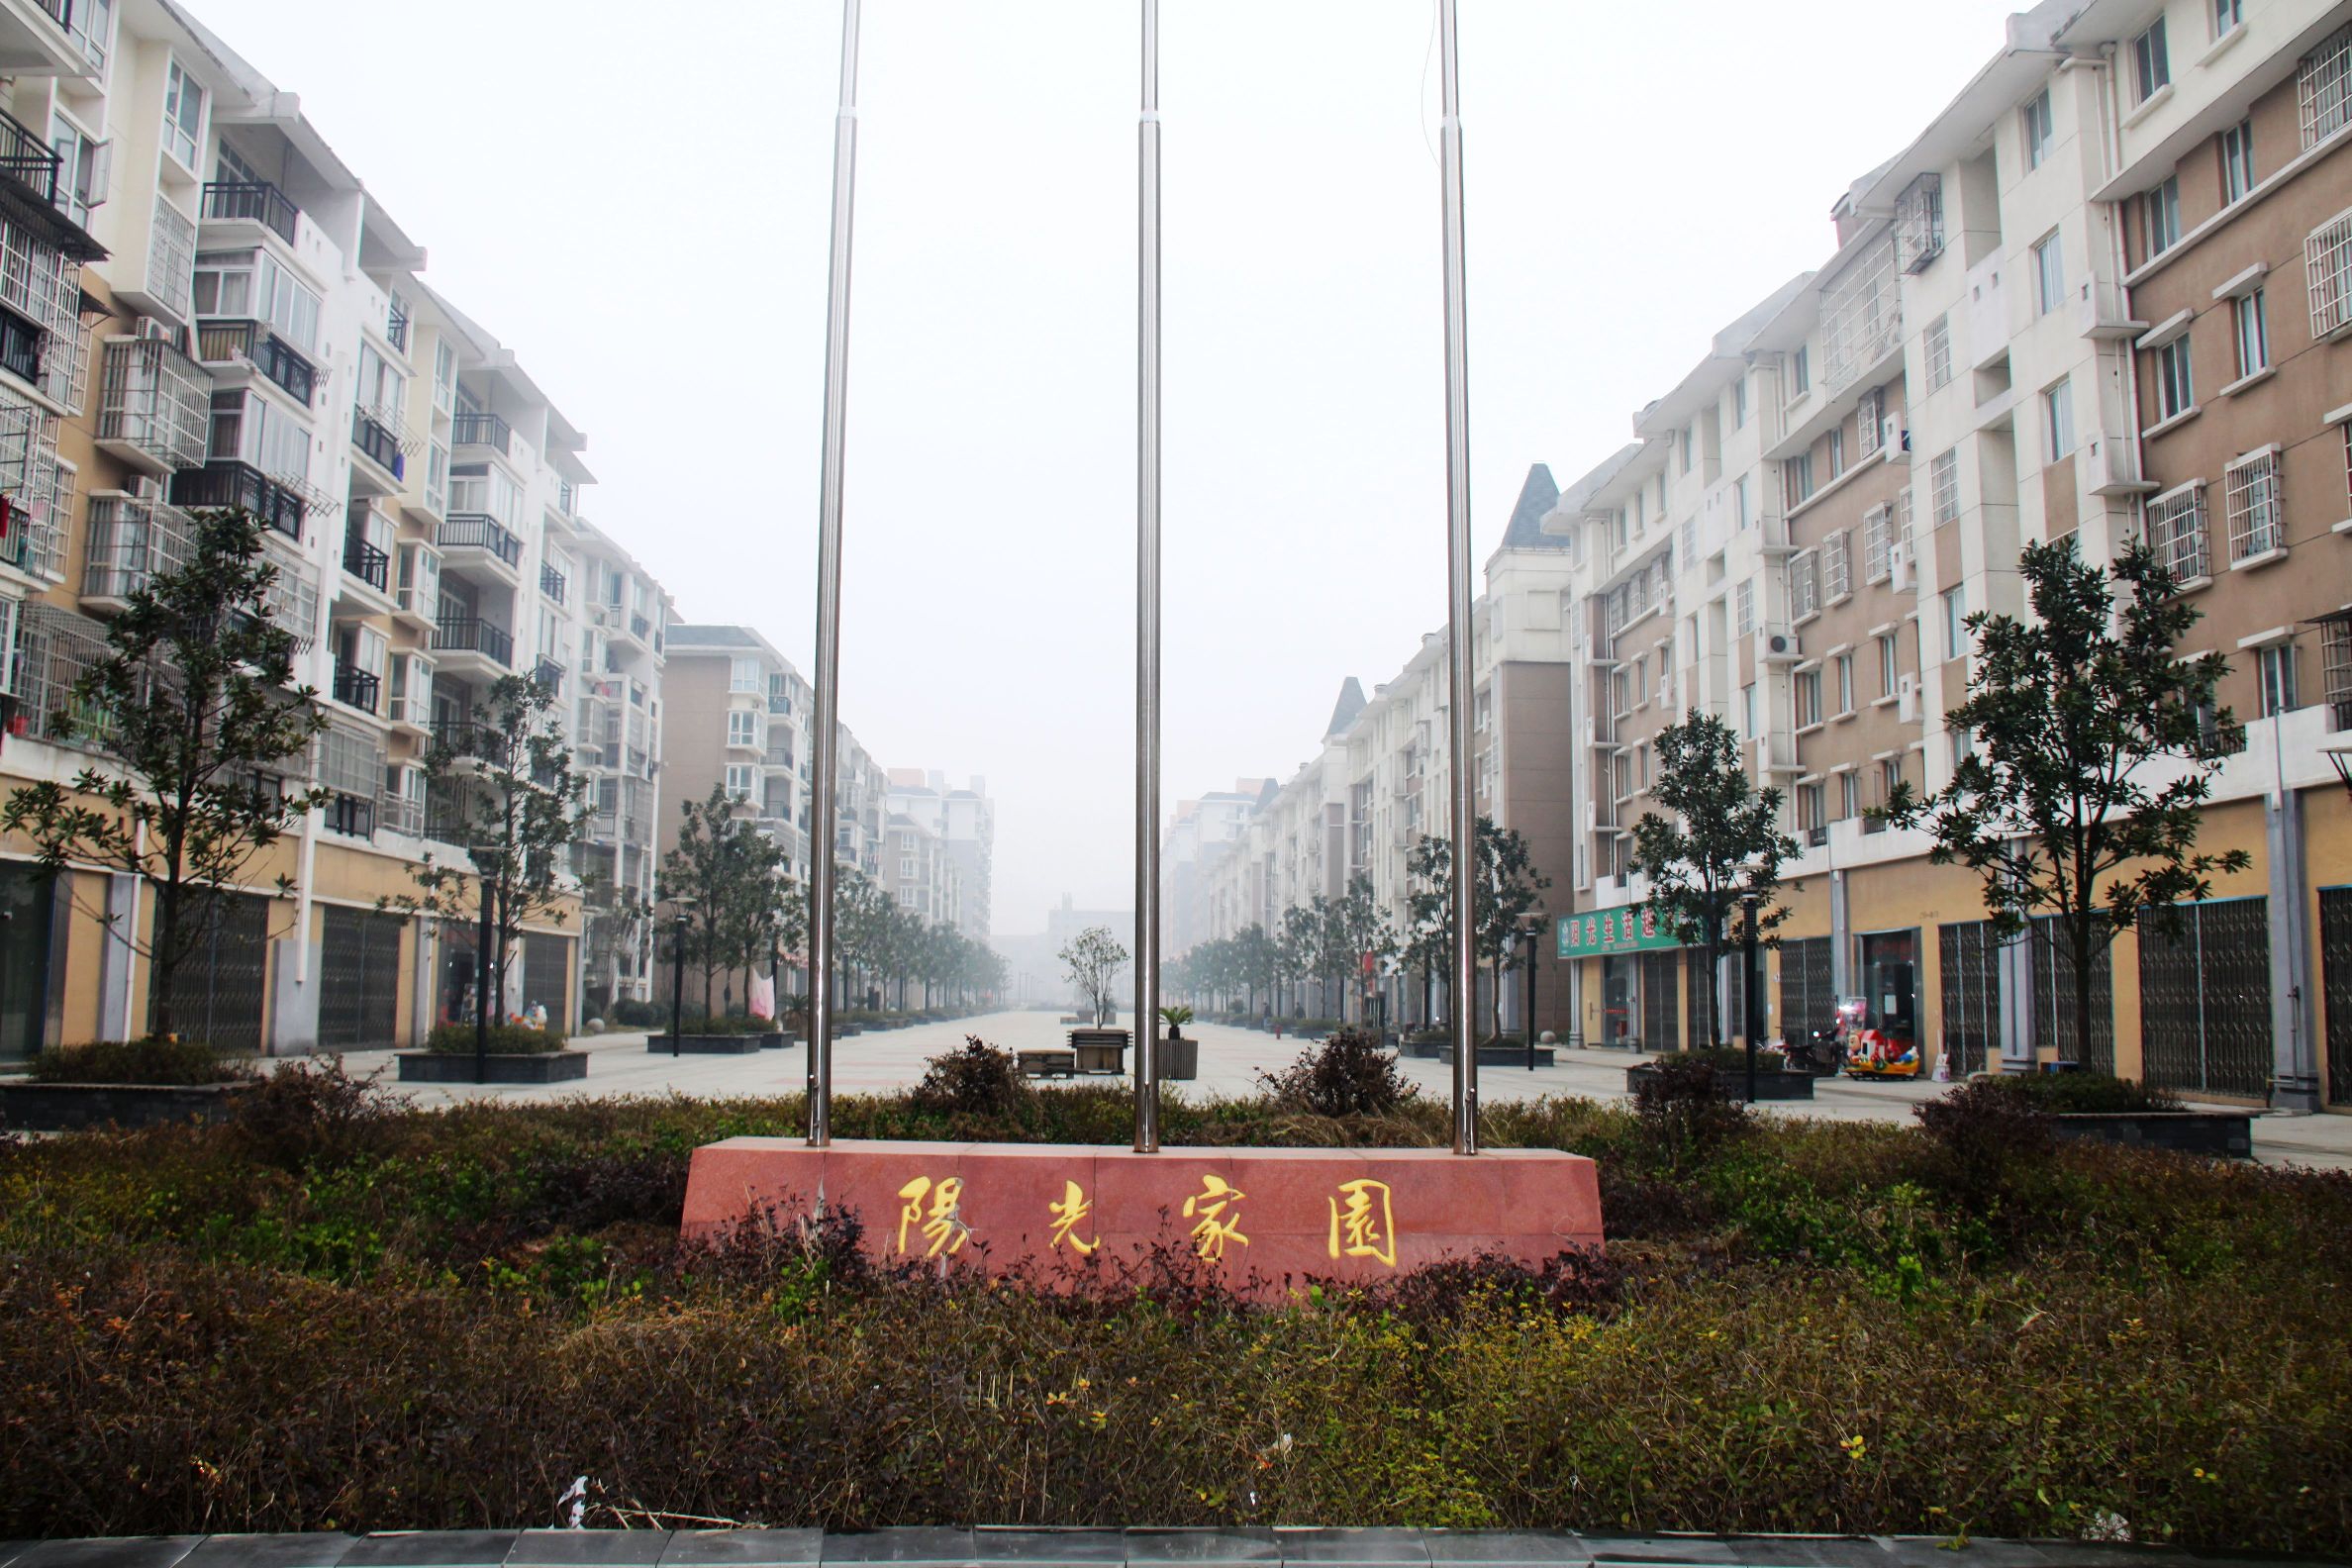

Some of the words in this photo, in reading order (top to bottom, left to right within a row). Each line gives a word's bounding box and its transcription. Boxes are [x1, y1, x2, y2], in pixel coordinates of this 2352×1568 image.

[1570, 904, 1676, 947] 阳光生活超
